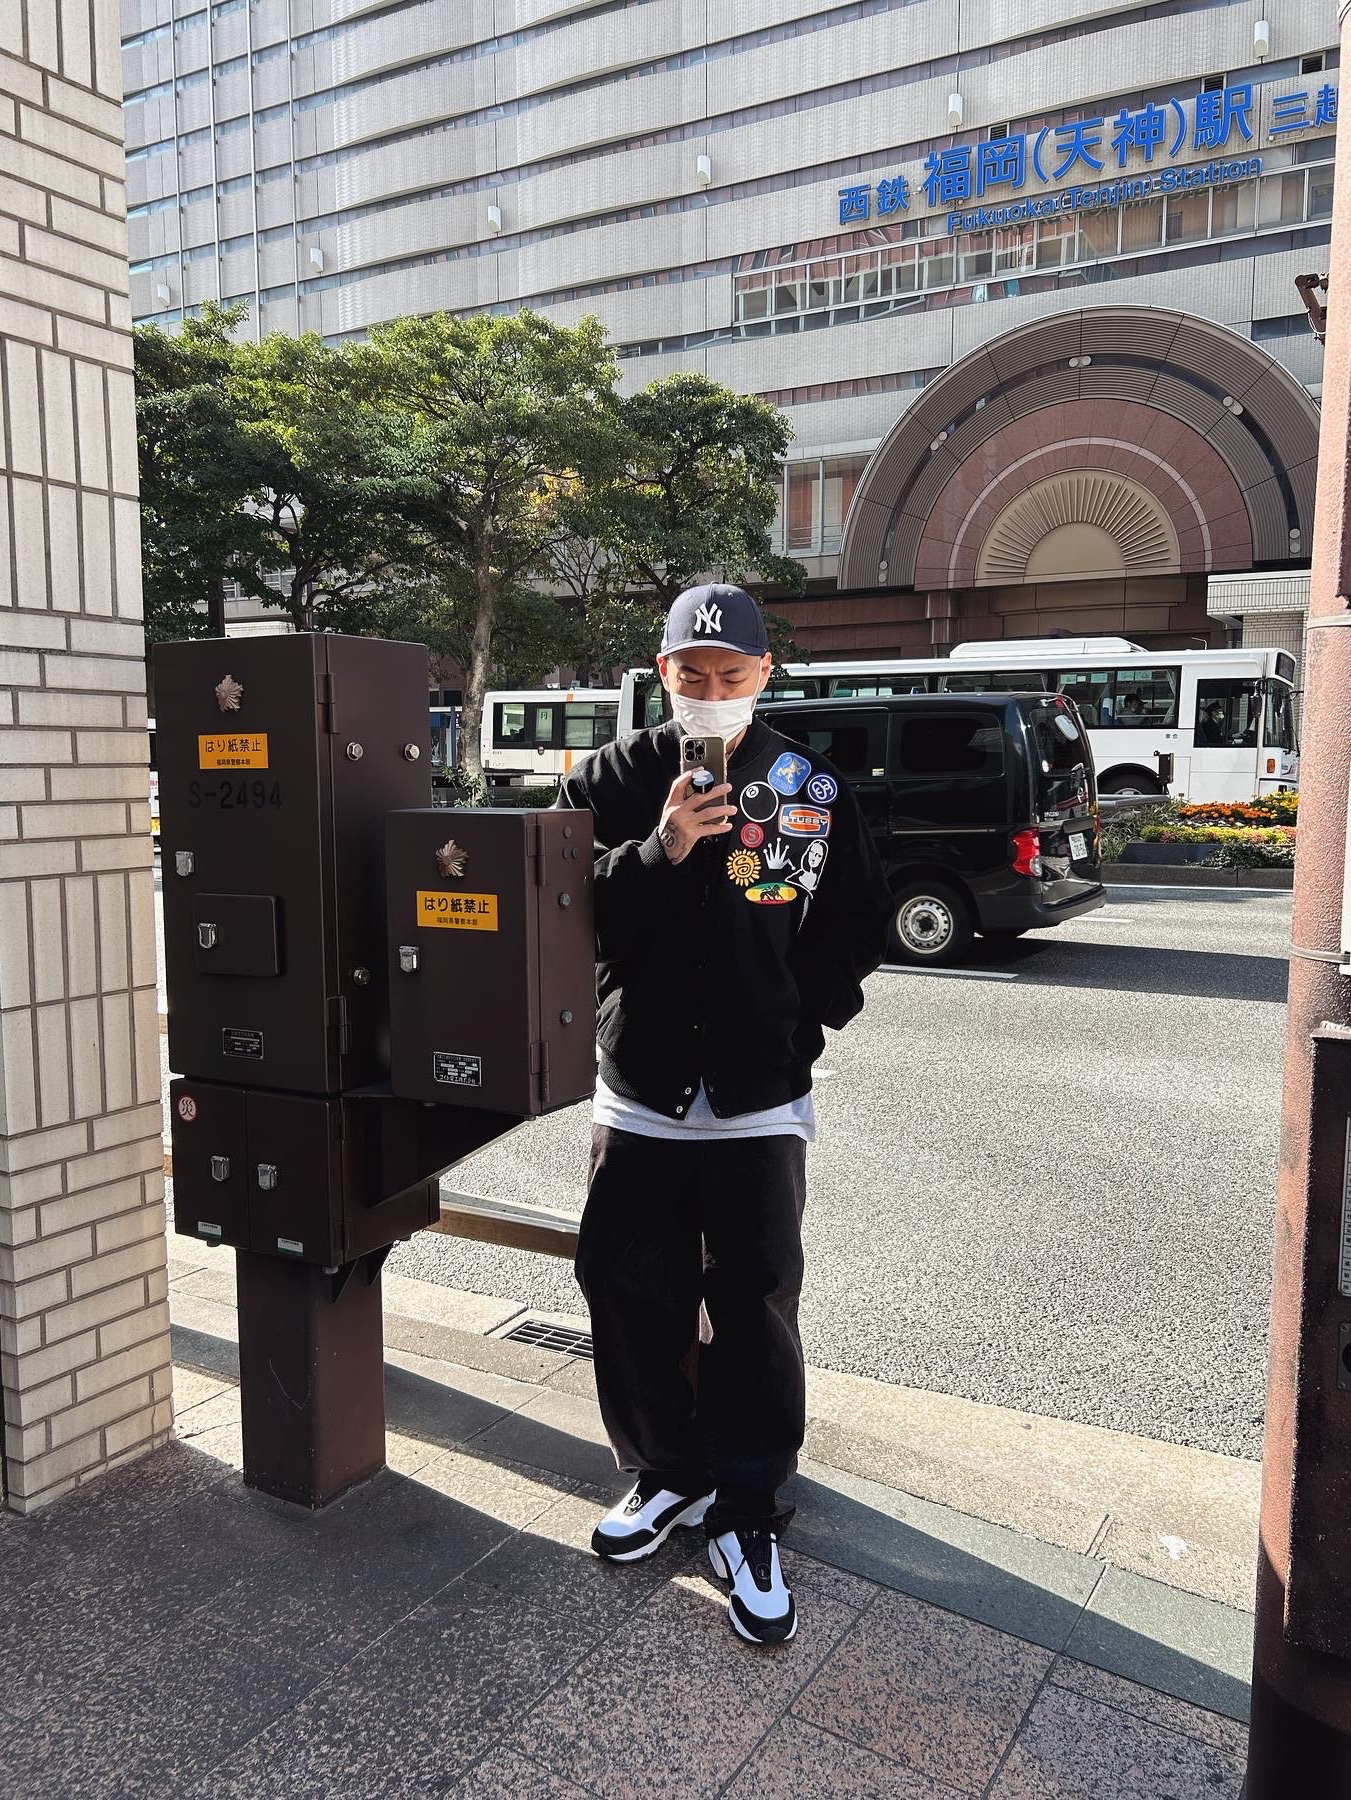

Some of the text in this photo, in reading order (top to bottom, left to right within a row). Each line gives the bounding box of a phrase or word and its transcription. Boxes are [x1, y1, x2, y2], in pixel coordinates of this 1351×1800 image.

[837, 174, 910, 226] 西鉄
[922, 83, 1253, 208] 福岡(天神)駅
[1160, 157, 1263, 193] Station
[693, 602, 723, 634] NY
[205, 738, 262, 753] はり紙禁止
[189, 780, 283, 809] S-2494
[424, 896, 490, 914] はり紙禁止
[181, 1098, 194, 1117] 災
